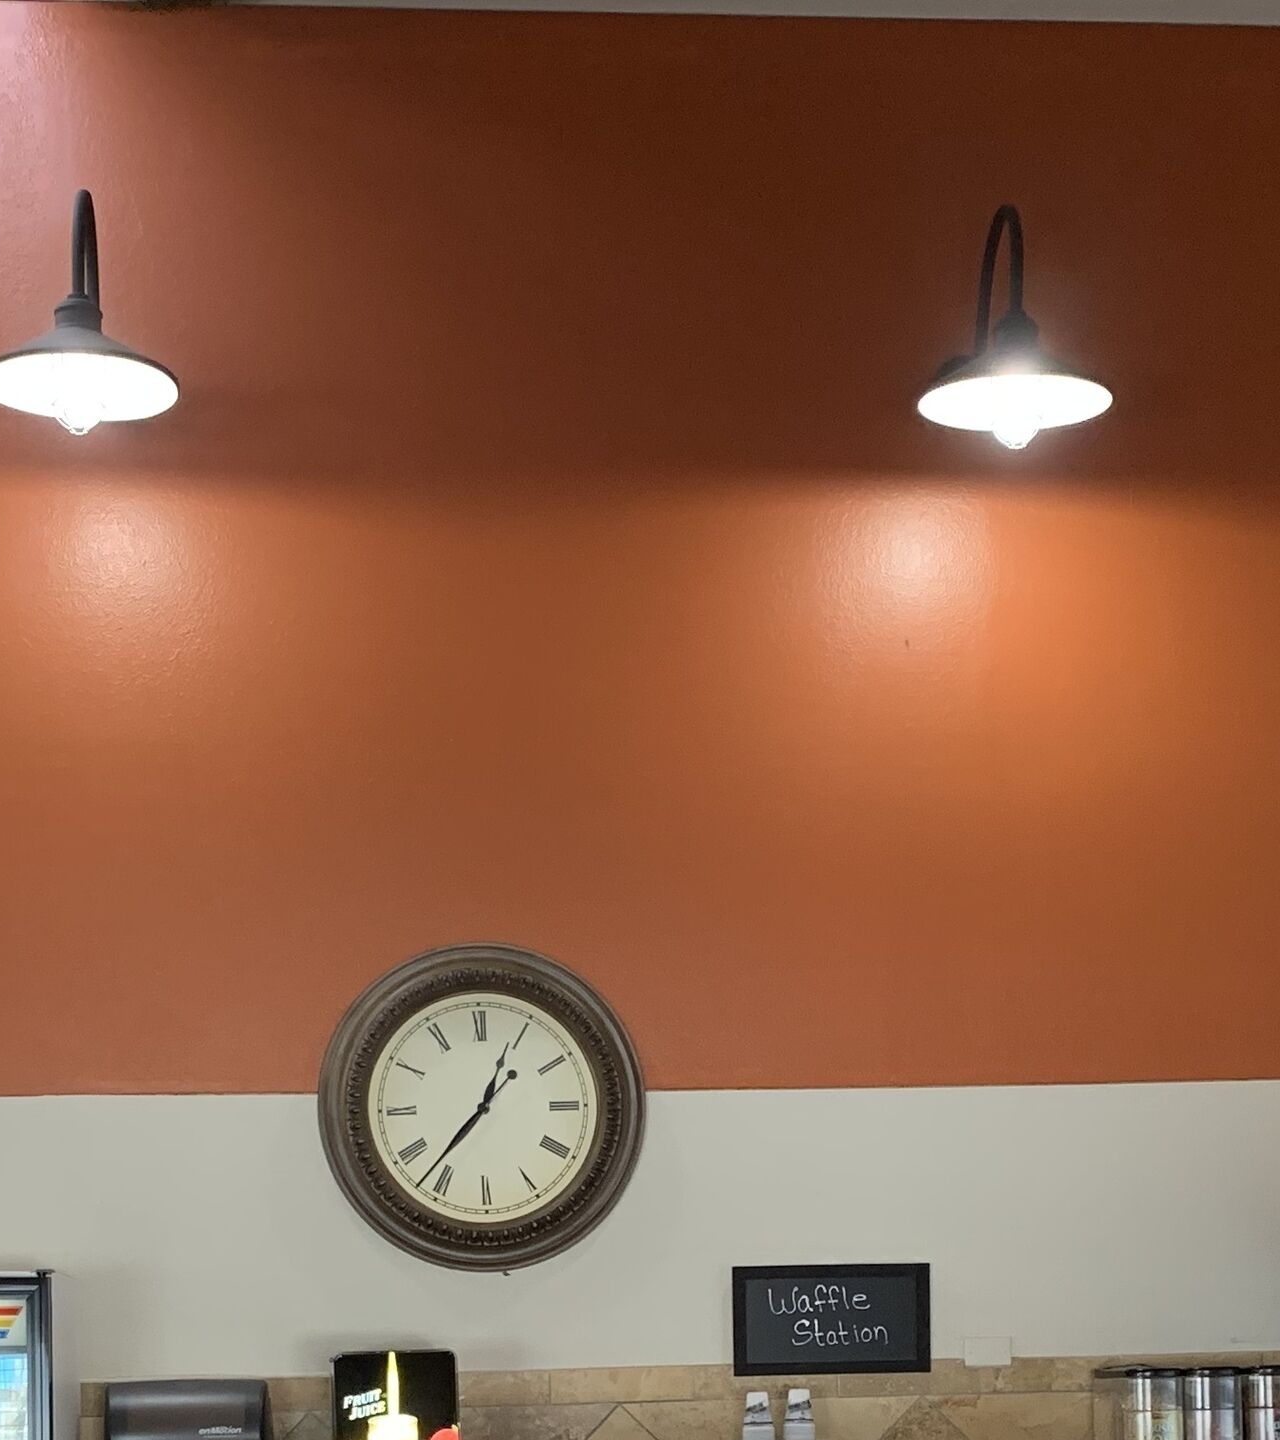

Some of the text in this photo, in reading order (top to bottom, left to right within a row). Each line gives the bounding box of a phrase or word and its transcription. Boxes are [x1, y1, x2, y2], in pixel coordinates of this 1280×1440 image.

[767, 1284, 871, 1316] Waffle
[791, 1318, 889, 1347] Station
[343, 1388, 382, 1409] FRUIT
[348, 1400, 386, 1421] JUICE
